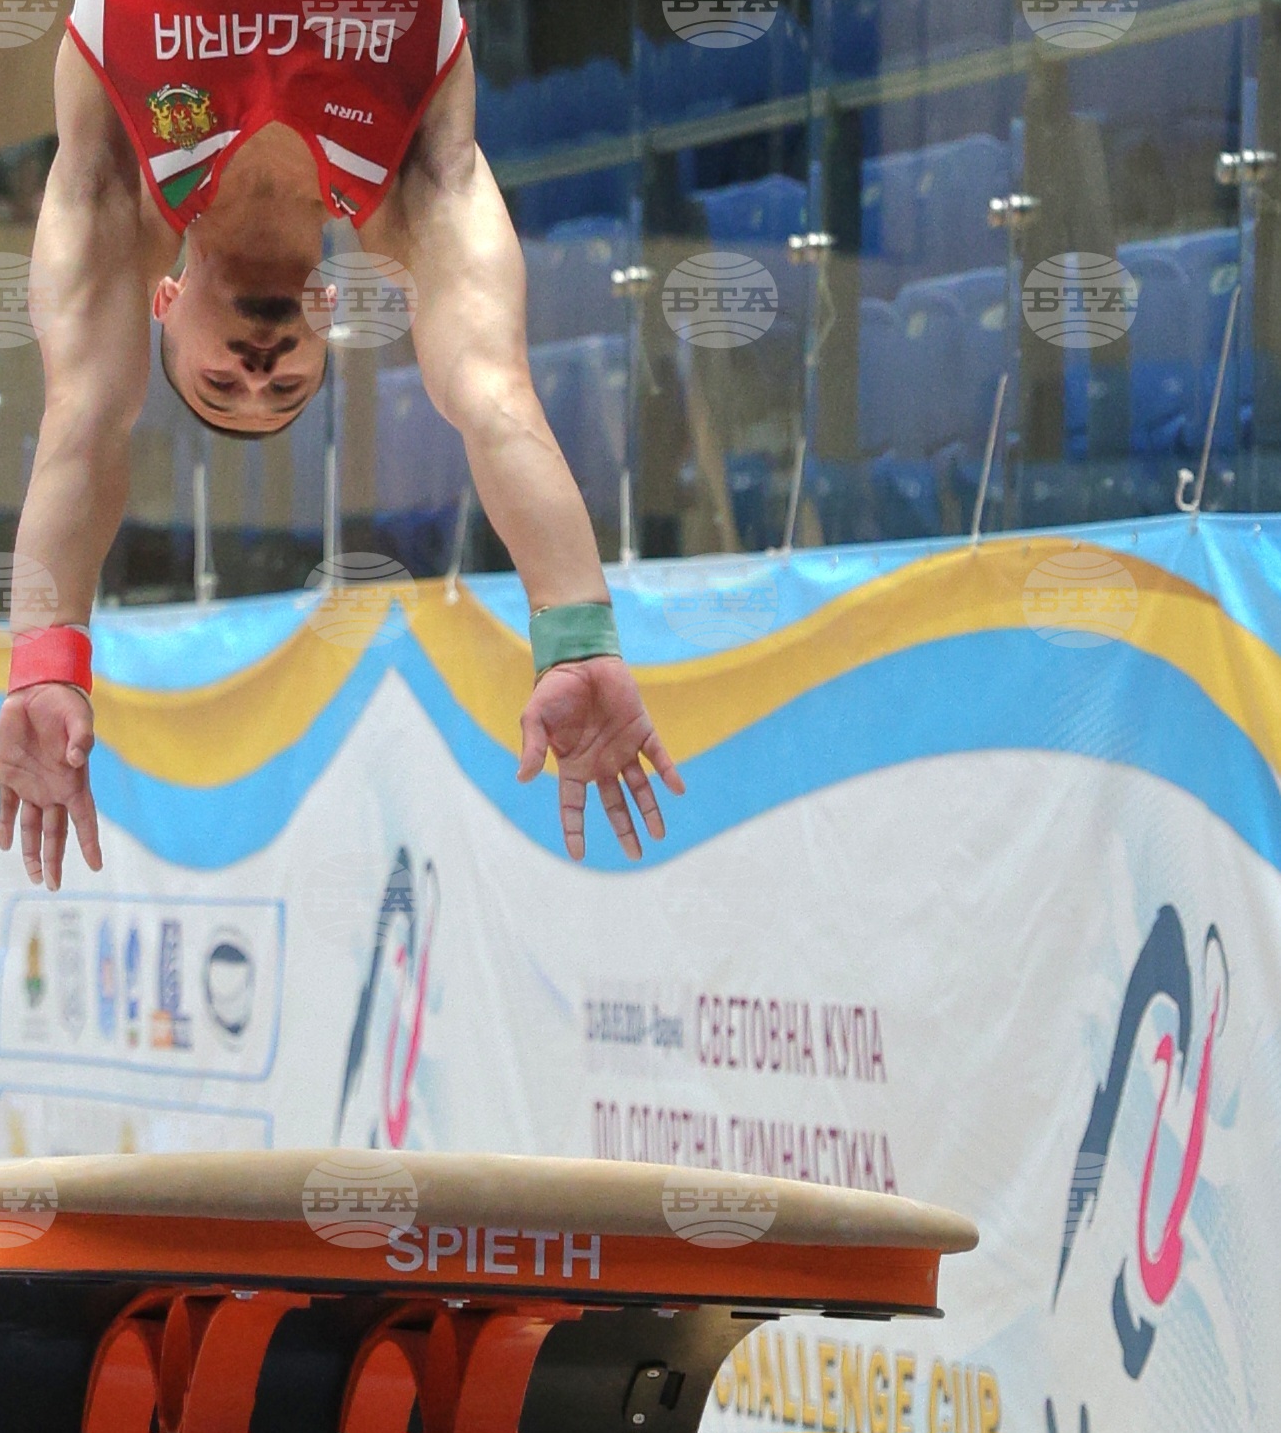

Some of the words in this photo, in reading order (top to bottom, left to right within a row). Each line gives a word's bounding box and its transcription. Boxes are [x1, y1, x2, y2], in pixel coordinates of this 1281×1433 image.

[154, 13, 395, 63] BULGARIA
[324, 102, 374, 125] TURN
[697, 993, 817, 1077] СВЕТОВНА
[821, 1002, 888, 1084] КУПА
[385, 1226, 601, 1280] SPIETH
